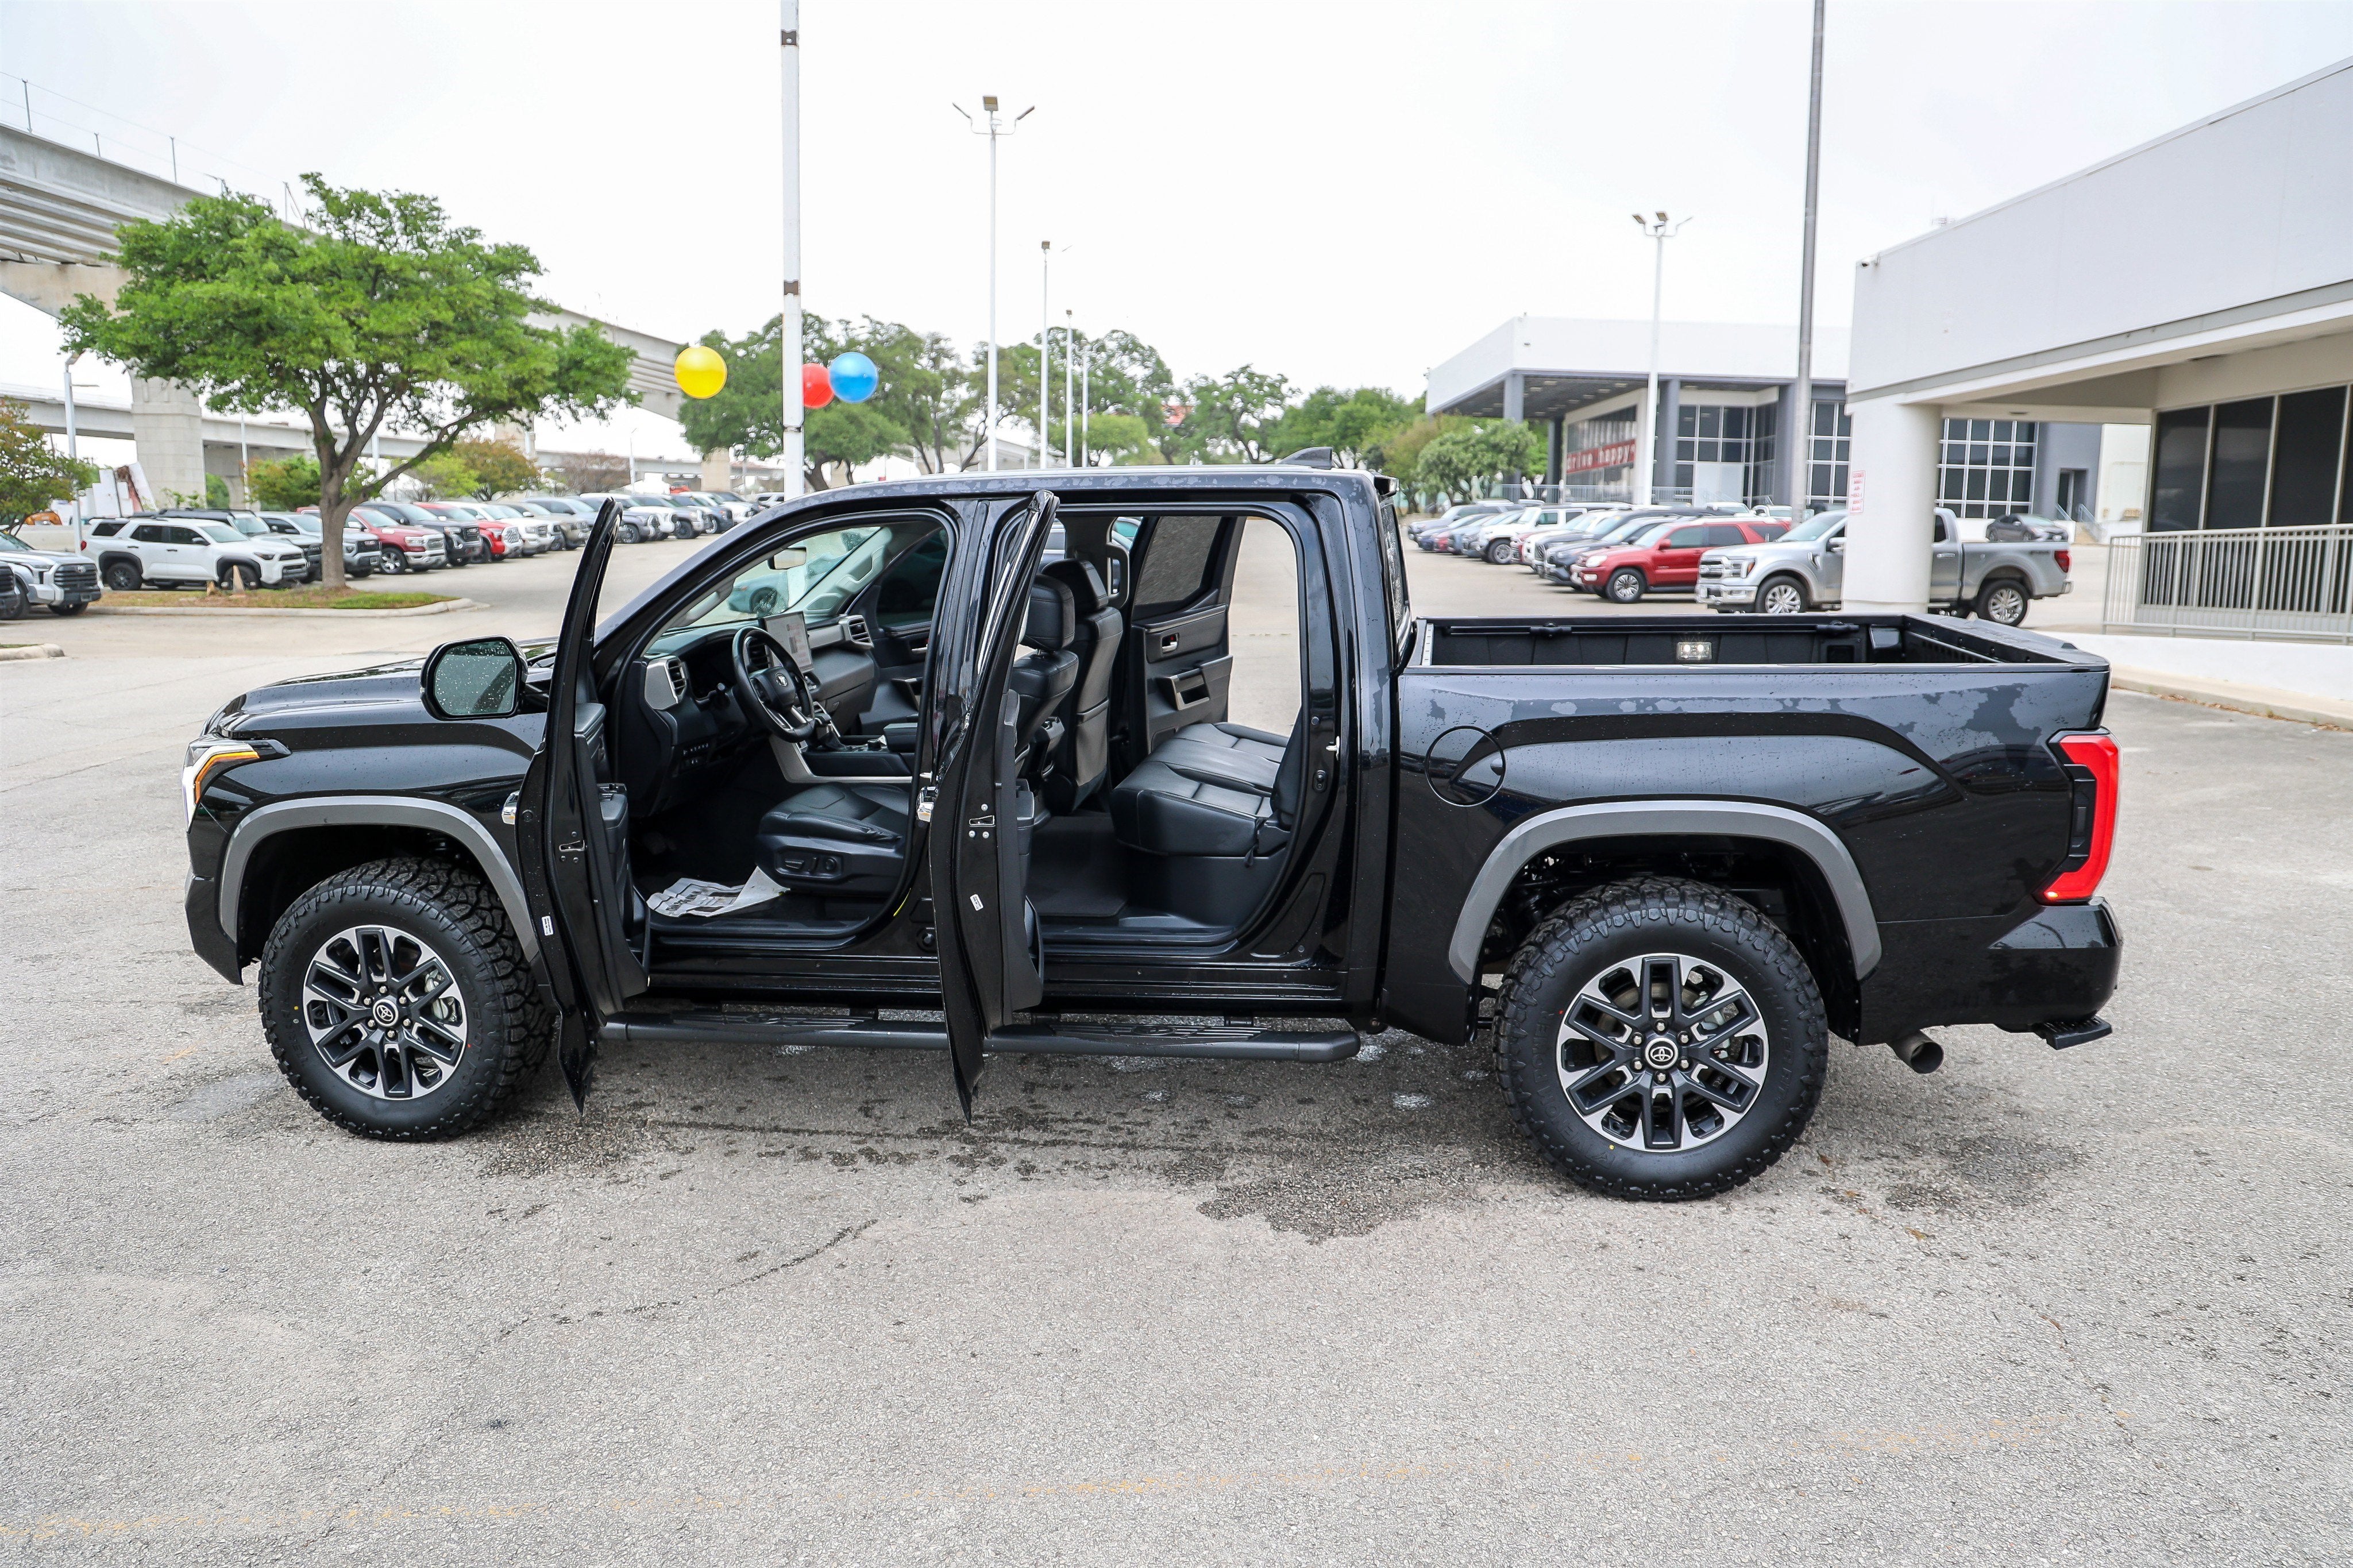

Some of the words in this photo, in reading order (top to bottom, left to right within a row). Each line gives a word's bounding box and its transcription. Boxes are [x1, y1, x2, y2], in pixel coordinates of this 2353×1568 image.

[1598, 445, 1630, 466] happy
[1532, 1010, 1553, 1083] POWER
[1537, 1086, 1588, 1152] VENOM
